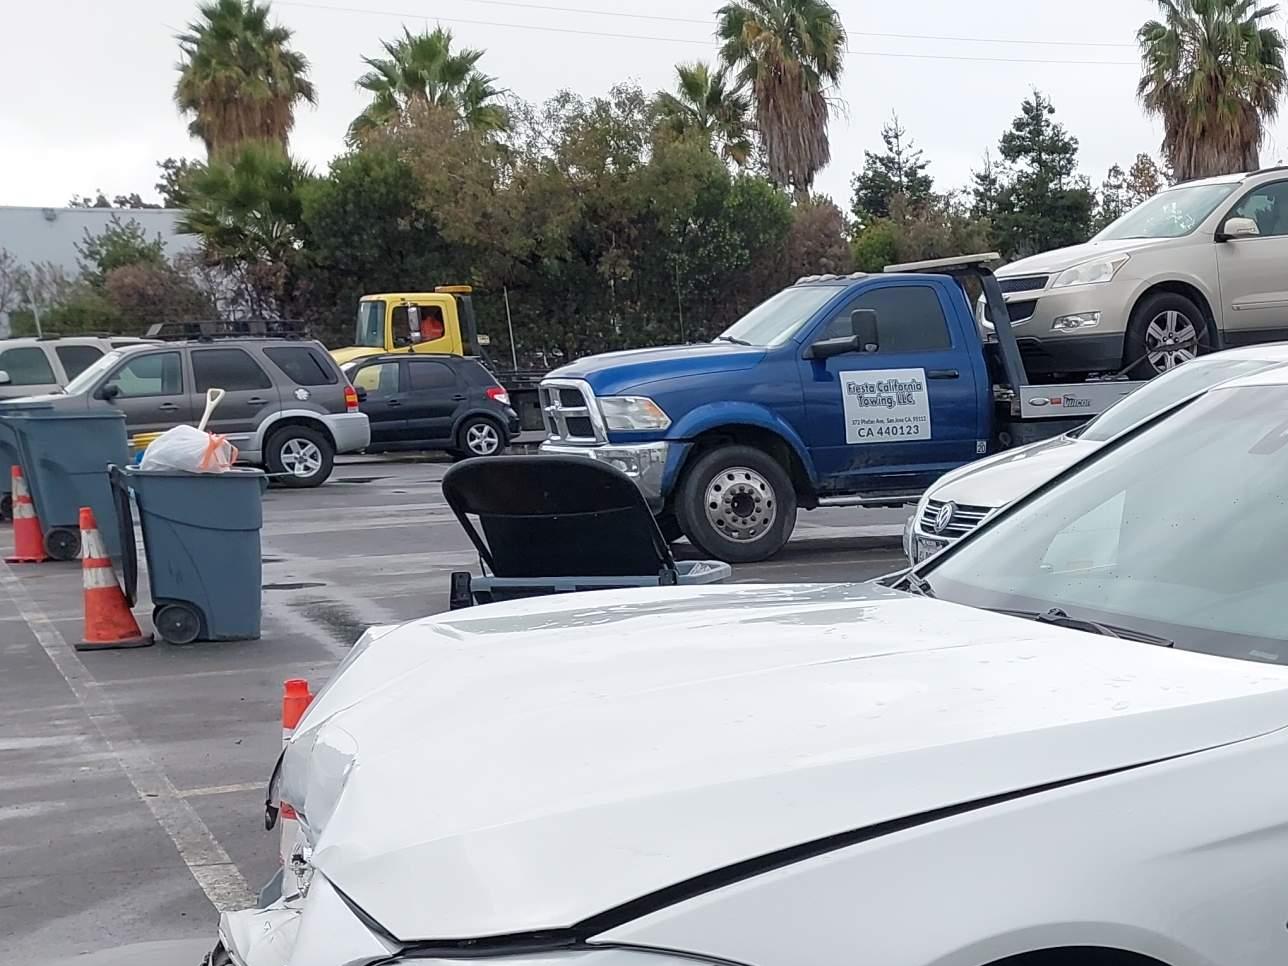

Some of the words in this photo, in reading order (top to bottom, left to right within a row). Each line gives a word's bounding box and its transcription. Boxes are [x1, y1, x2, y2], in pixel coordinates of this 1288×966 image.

[847, 381, 876, 395] Fiesta
[877, 378, 923, 393] California
[857, 427, 874, 438] CA
[877, 424, 920, 437] 440123
